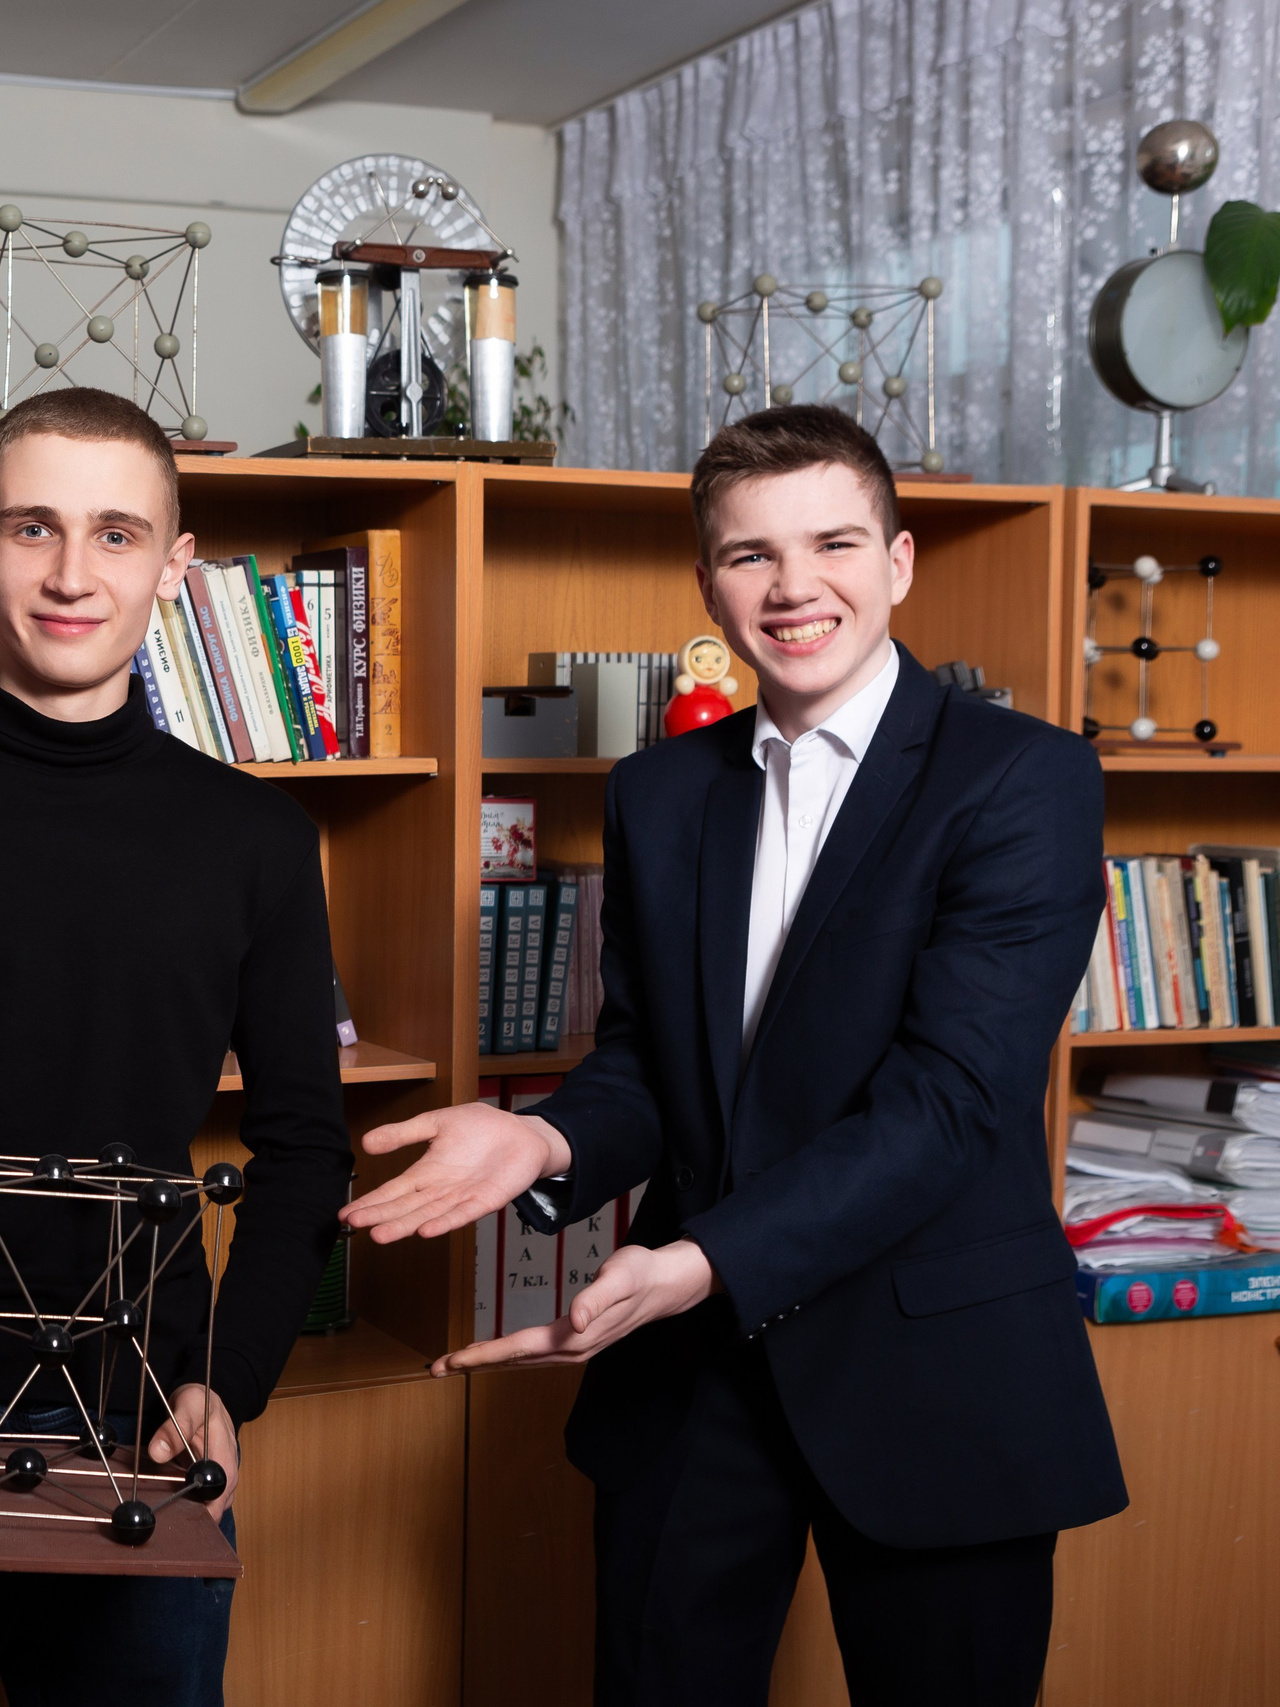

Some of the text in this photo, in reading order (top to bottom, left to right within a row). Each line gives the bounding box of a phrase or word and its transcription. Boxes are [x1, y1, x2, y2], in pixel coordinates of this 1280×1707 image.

[280, 585, 294, 626] ФИЗИКА
[307, 598, 314, 611] 6
[352, 566, 366, 633] ФИЗИКИ
[324, 608, 332, 620] 5
[238, 595, 259, 658] ФИЗИКА
[153, 628, 170, 673] ФИЗИКА
[291, 640, 303, 664] 1000
[354, 637, 367, 678] КУРС
[200, 605, 238, 722] ФИЗИКА ВОКРУГ НАС
[296, 665, 311, 695] ЗАДАЧ
[175, 709, 185, 723] 11
[384, 724, 393, 736] 2
[504, 1022, 512, 1035] 3
[524, 1023, 531, 1033] 4
[549, 1017, 556, 1027] 5
[509, 1272, 548, 1288] 7 кл.
[568, 1269, 595, 1285] 8 к
